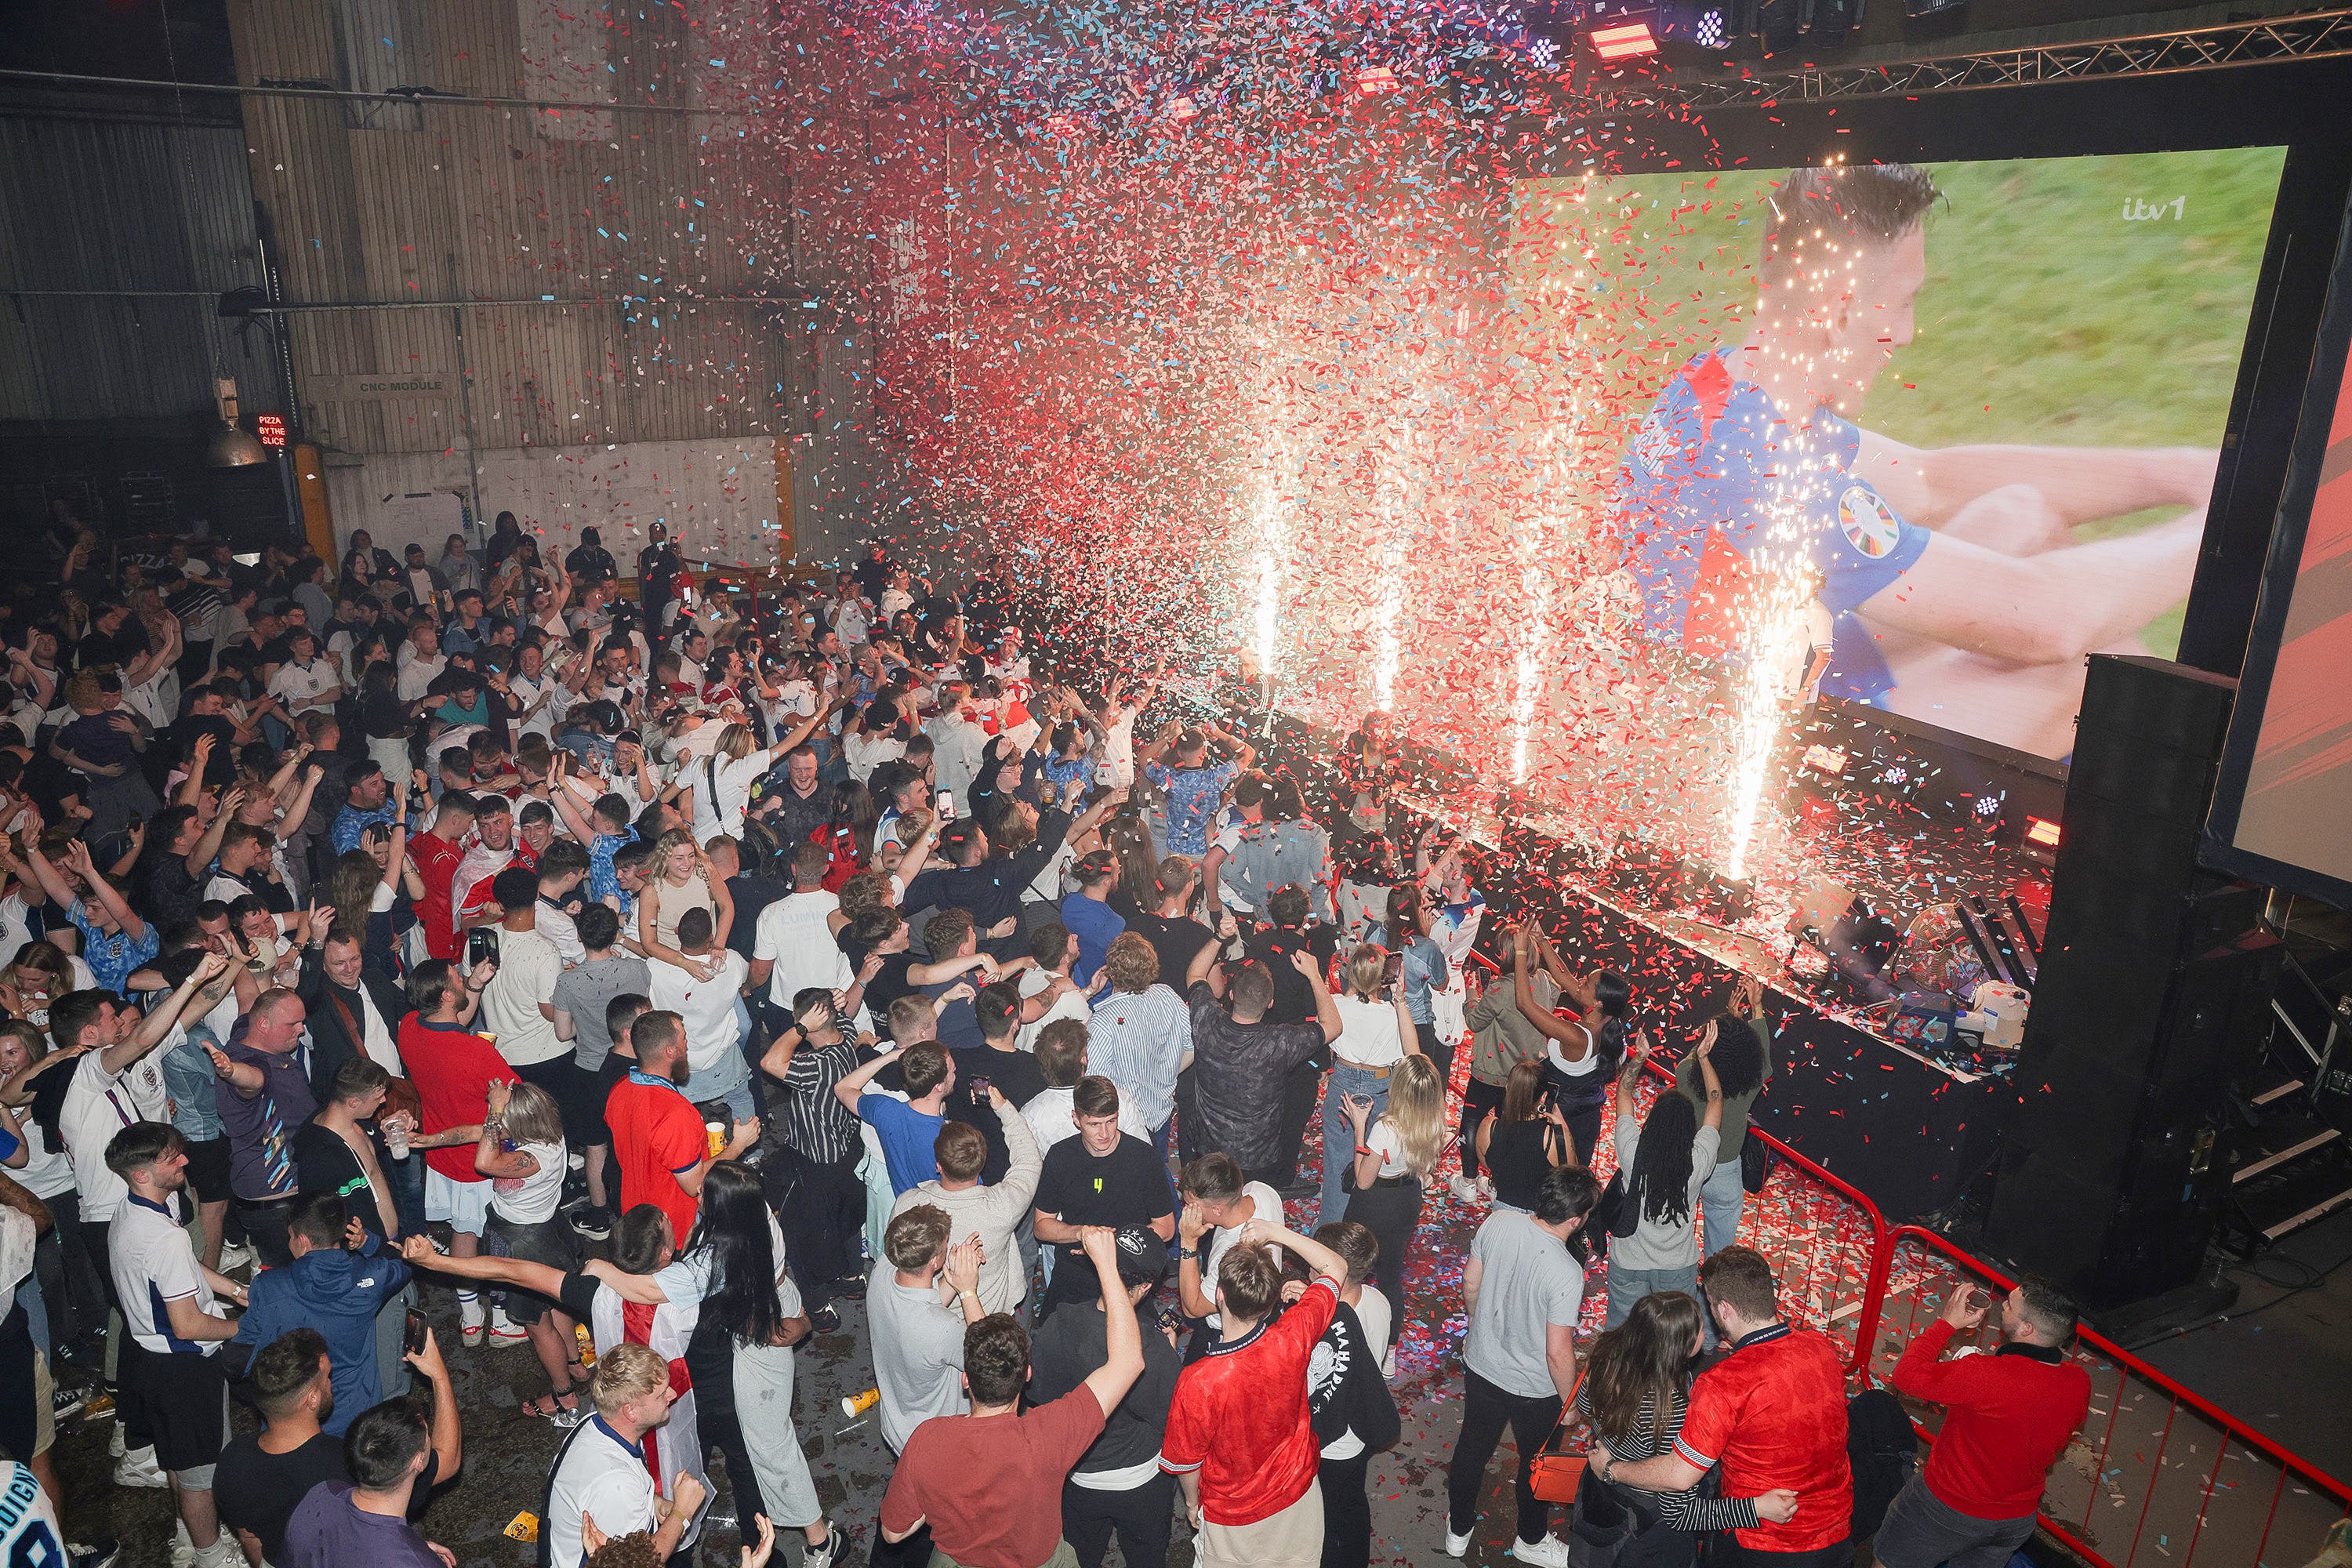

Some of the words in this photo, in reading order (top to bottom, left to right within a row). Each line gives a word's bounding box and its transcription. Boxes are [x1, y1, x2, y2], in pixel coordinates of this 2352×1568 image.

[2123, 195, 2186, 221] itv1
[360, 383, 387, 392] CNC
[390, 381, 443, 391] MODULE
[259, 416, 281, 424] PIZZA
[259, 426, 270, 435] BY
[270, 427, 285, 436] THE
[262, 436, 285, 445] SLICE
